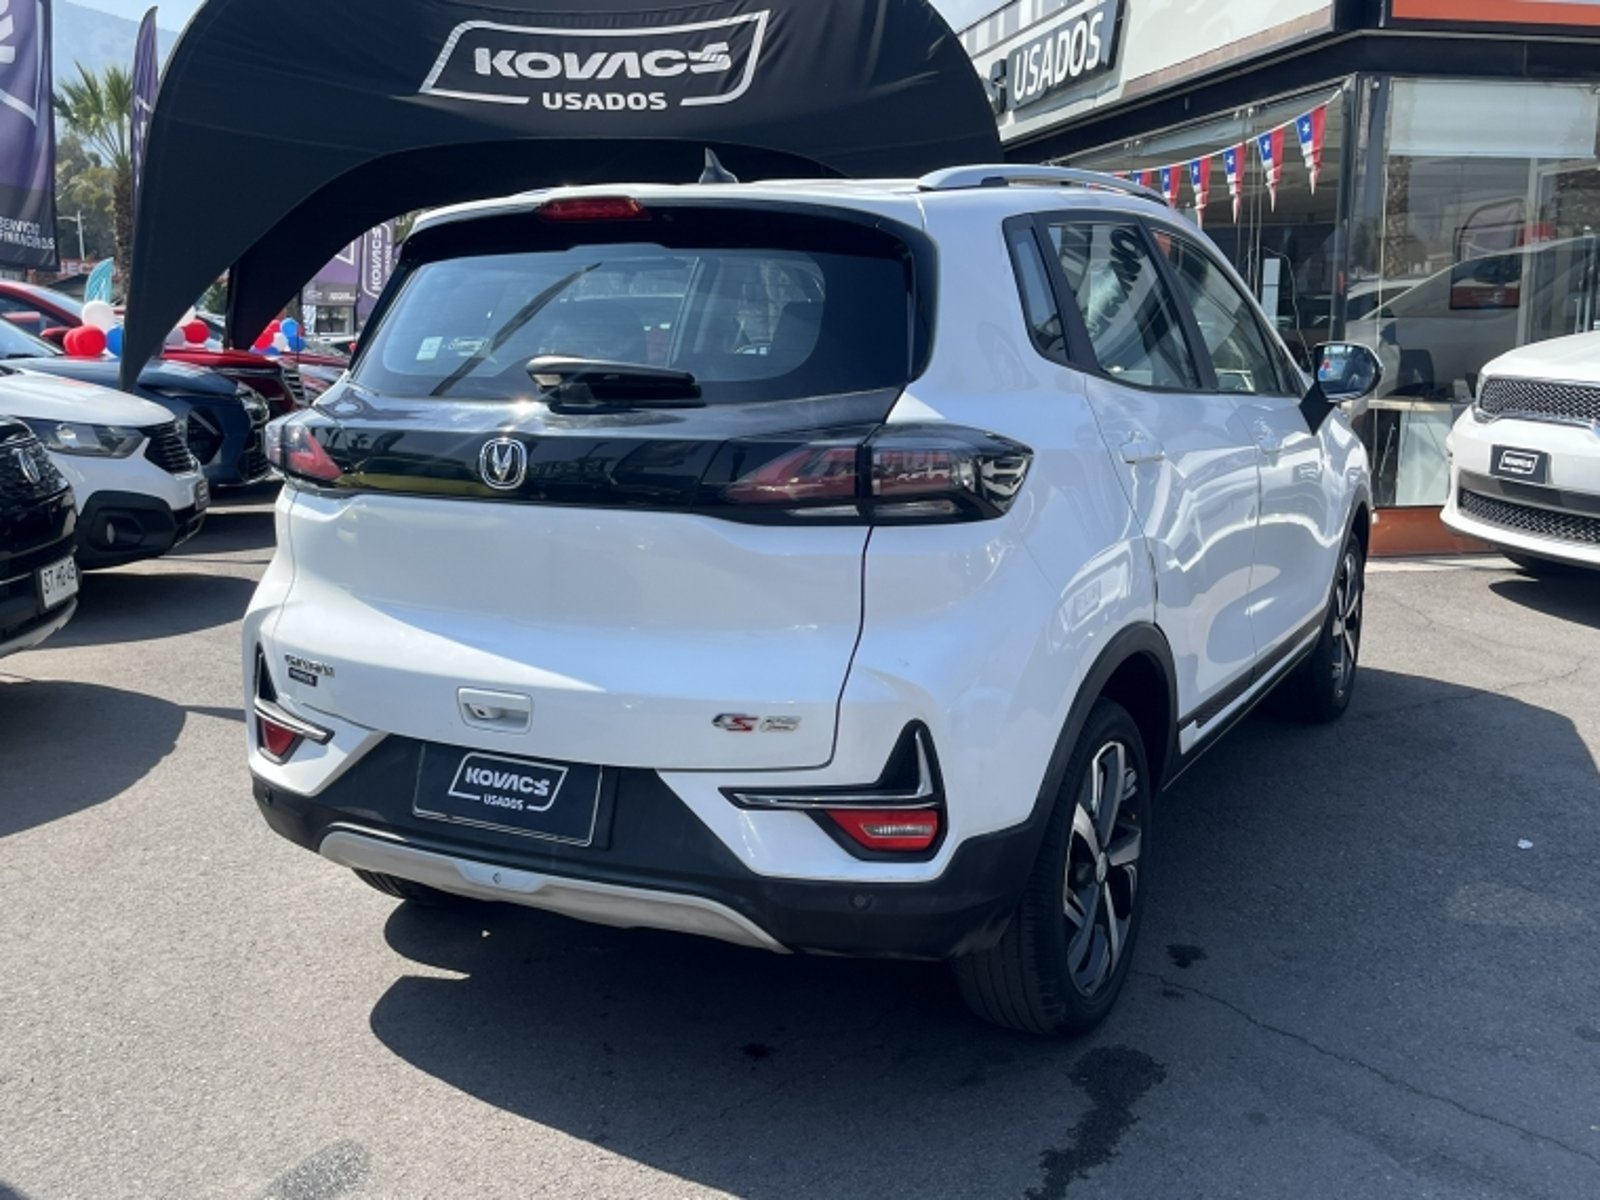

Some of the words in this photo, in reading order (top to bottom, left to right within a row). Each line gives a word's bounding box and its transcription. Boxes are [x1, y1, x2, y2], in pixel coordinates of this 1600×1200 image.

[475, 42, 731, 80] KOVACS
[1014, 11, 1104, 101] USADOS
[542, 92, 667, 110] USADOS
[465, 766, 550, 797] KOVACS
[483, 794, 524, 811] USADOS
